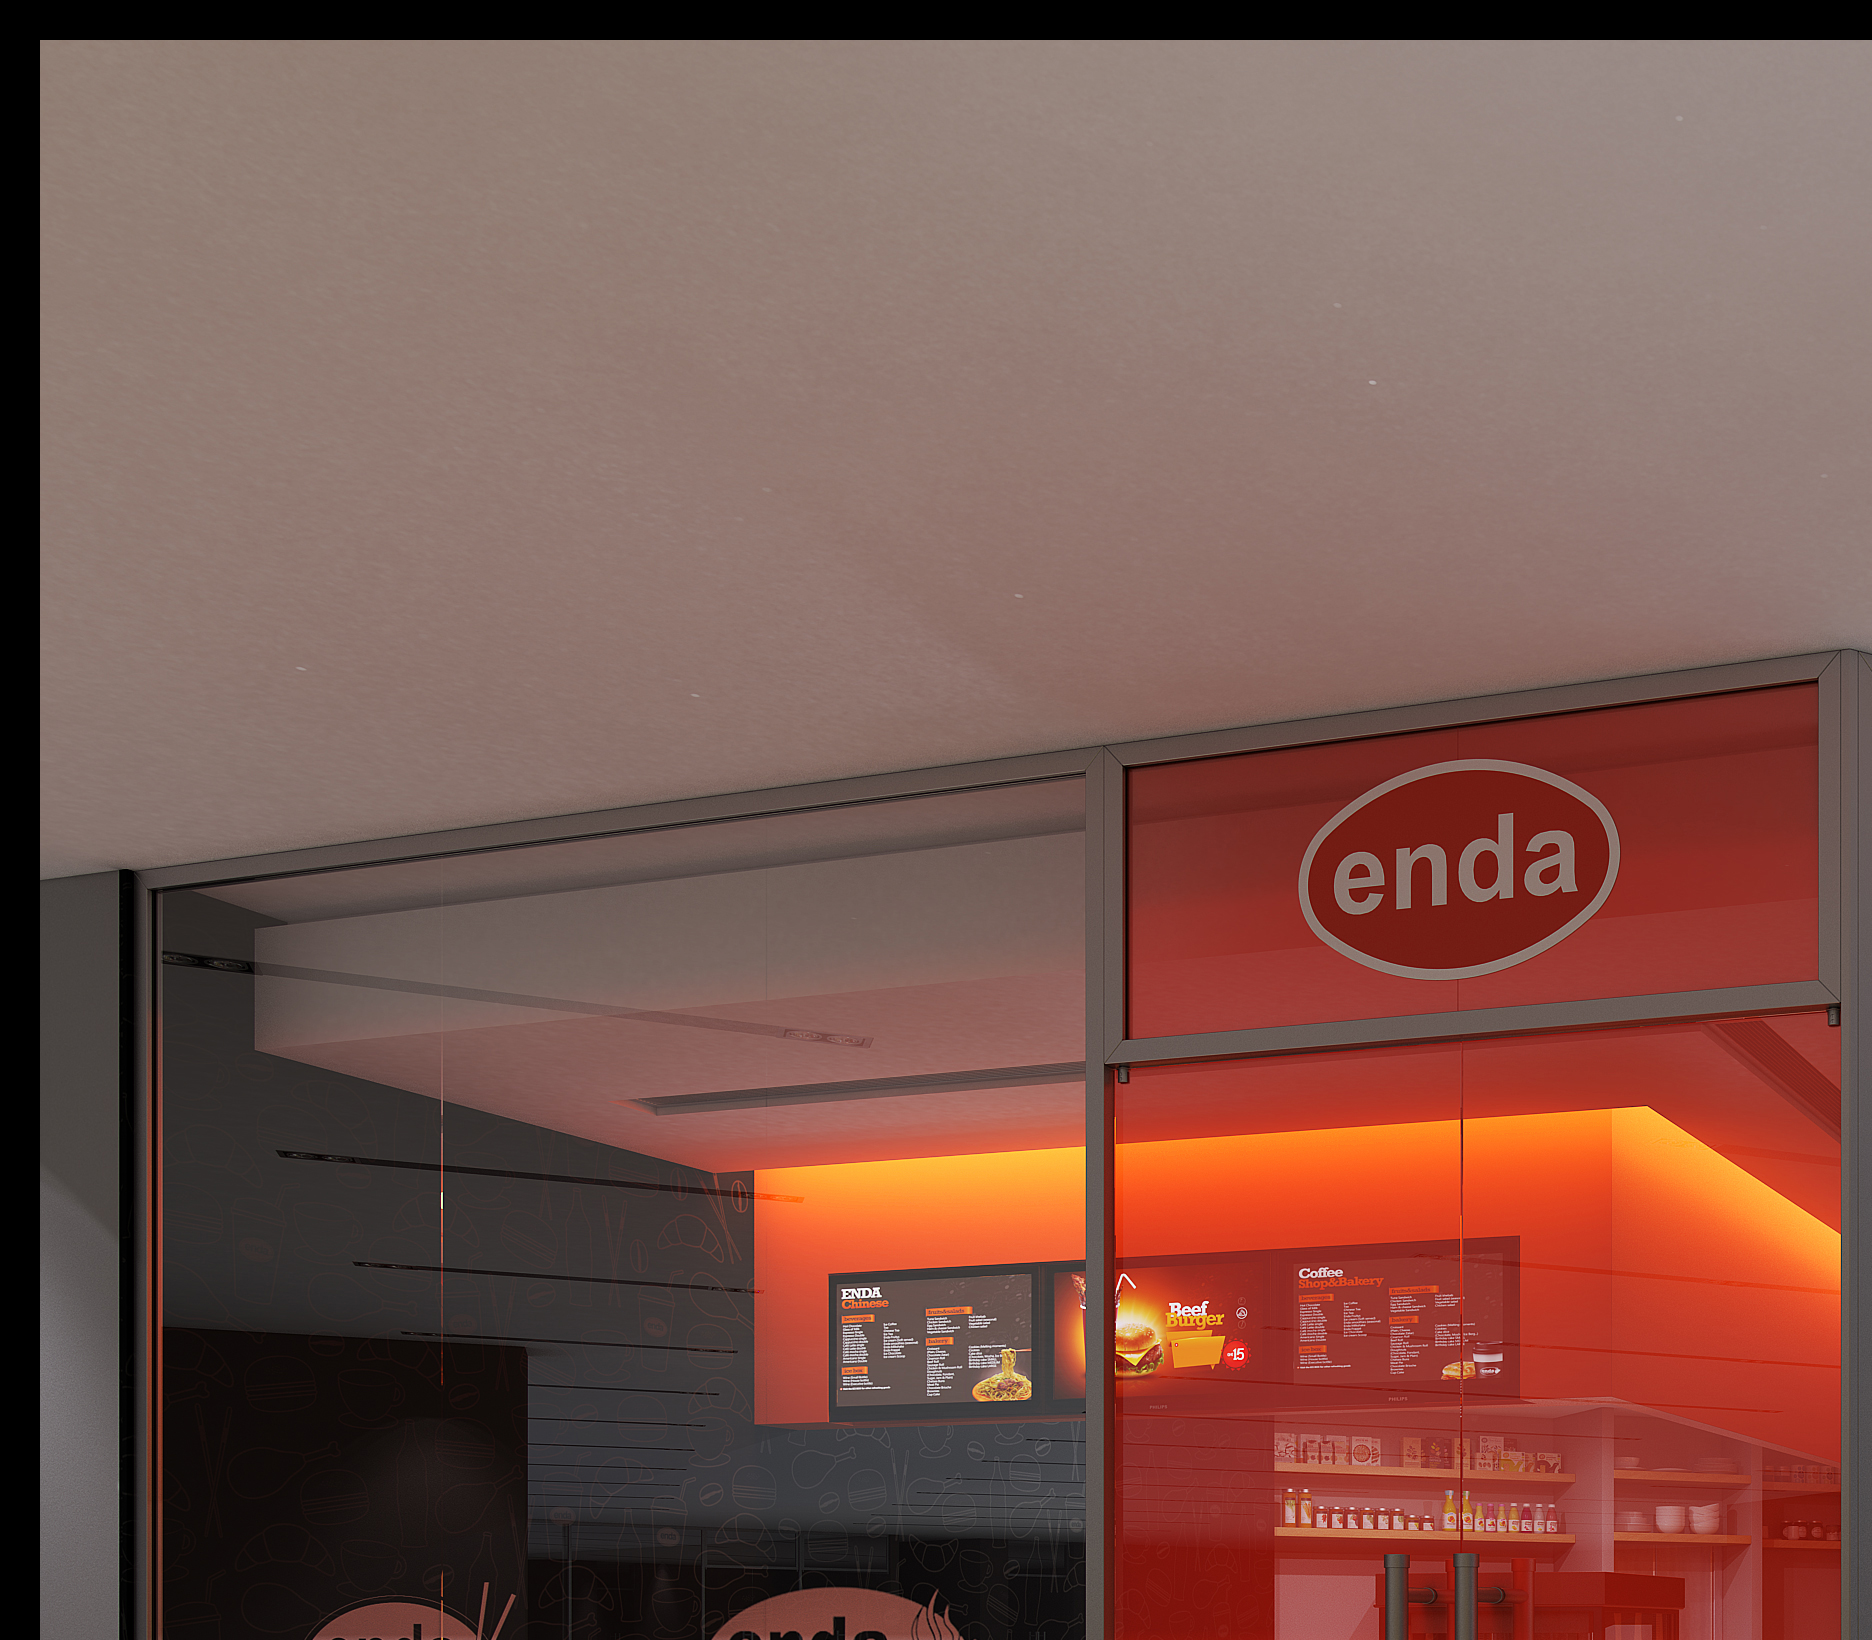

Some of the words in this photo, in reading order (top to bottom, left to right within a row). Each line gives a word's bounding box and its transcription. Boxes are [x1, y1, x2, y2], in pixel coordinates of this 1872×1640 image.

[1333, 812, 1578, 915] enda
[1299, 1267, 1344, 1278] Coffee
[1299, 1276, 1384, 1290] Shop&Bakery
[841, 1286, 882, 1300] ENDA
[841, 1299, 889, 1309] Chinese
[1169, 1301, 1209, 1317] Beef
[1165, 1312, 1225, 1330] Burger
